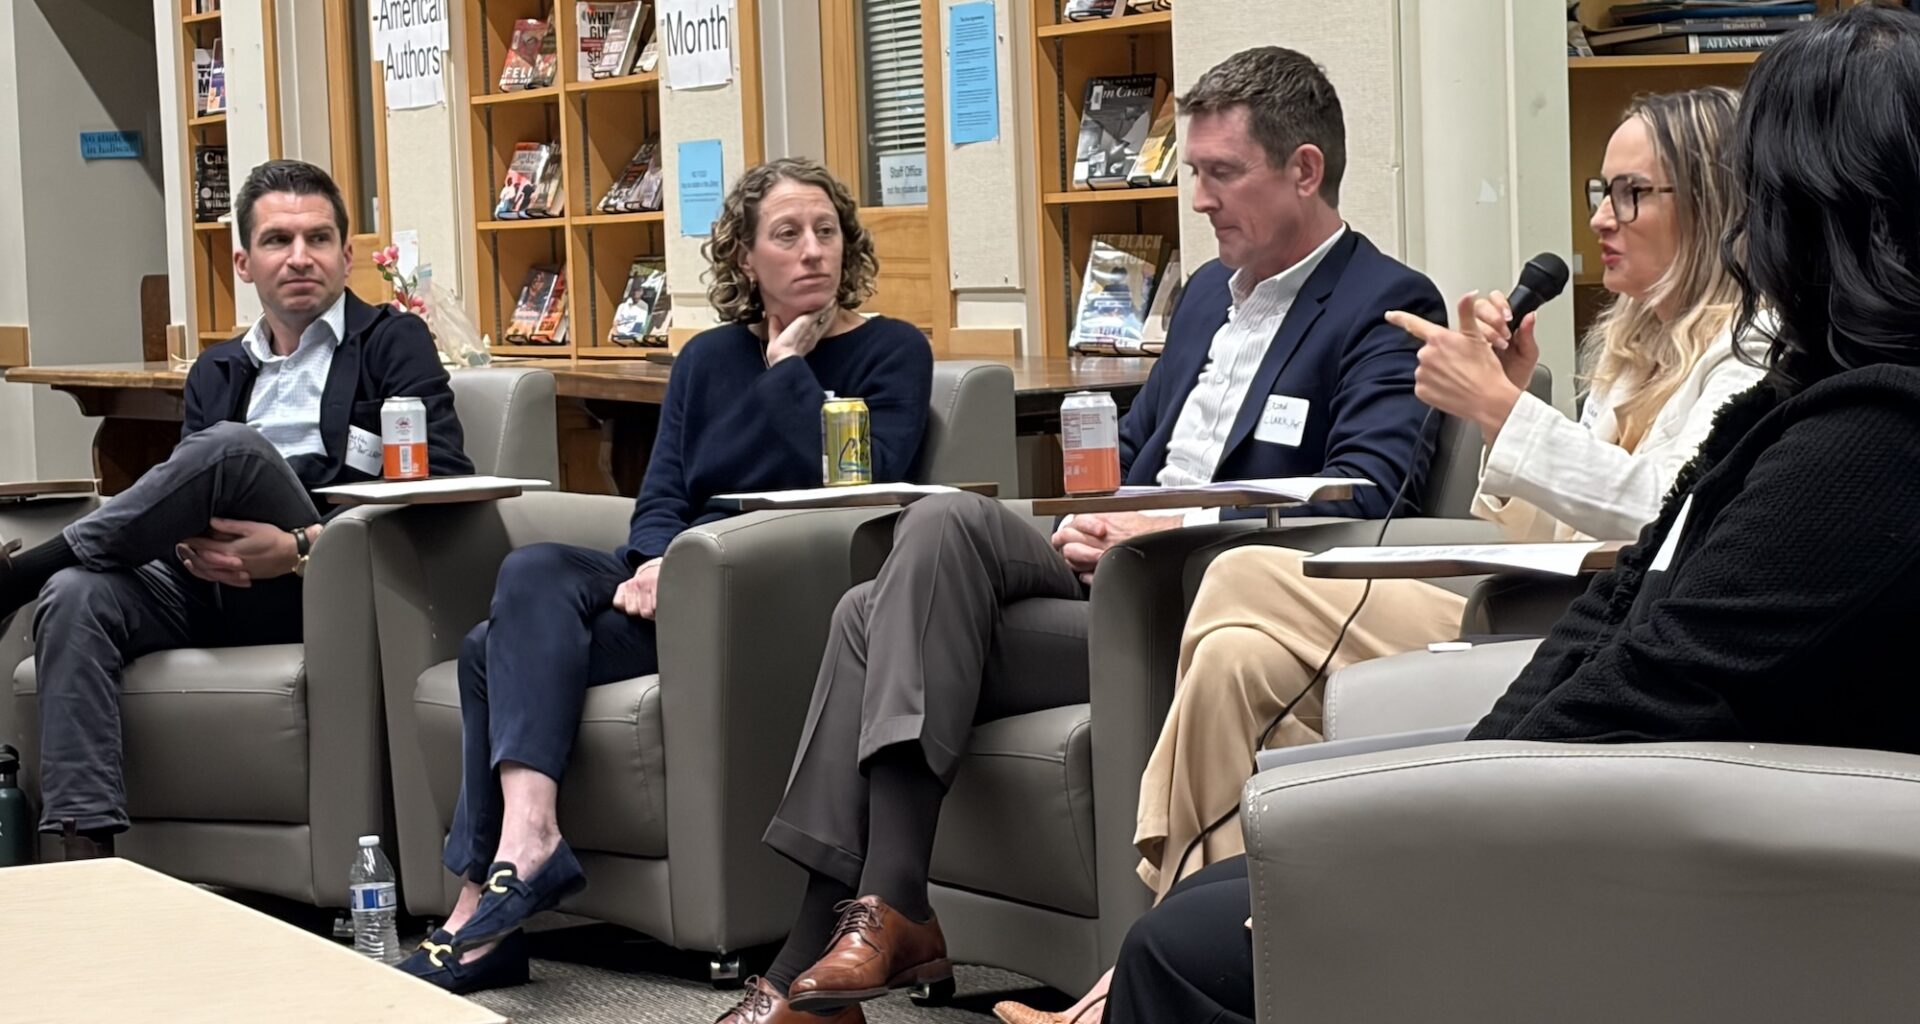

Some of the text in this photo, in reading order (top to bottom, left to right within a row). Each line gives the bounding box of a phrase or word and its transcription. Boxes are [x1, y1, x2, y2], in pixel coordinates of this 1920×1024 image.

[587, 12, 615, 24] WHIT
[667, 4, 728, 56] Month
[1707, 36, 1778, 48] ATLAS OF WOR
[385, 40, 440, 81] Authors
[505, 67, 533, 78] FELI
[204, 152, 229, 165] Cas
[890, 165, 922, 178] Staff Office
[1119, 234, 1163, 249] BLACK
